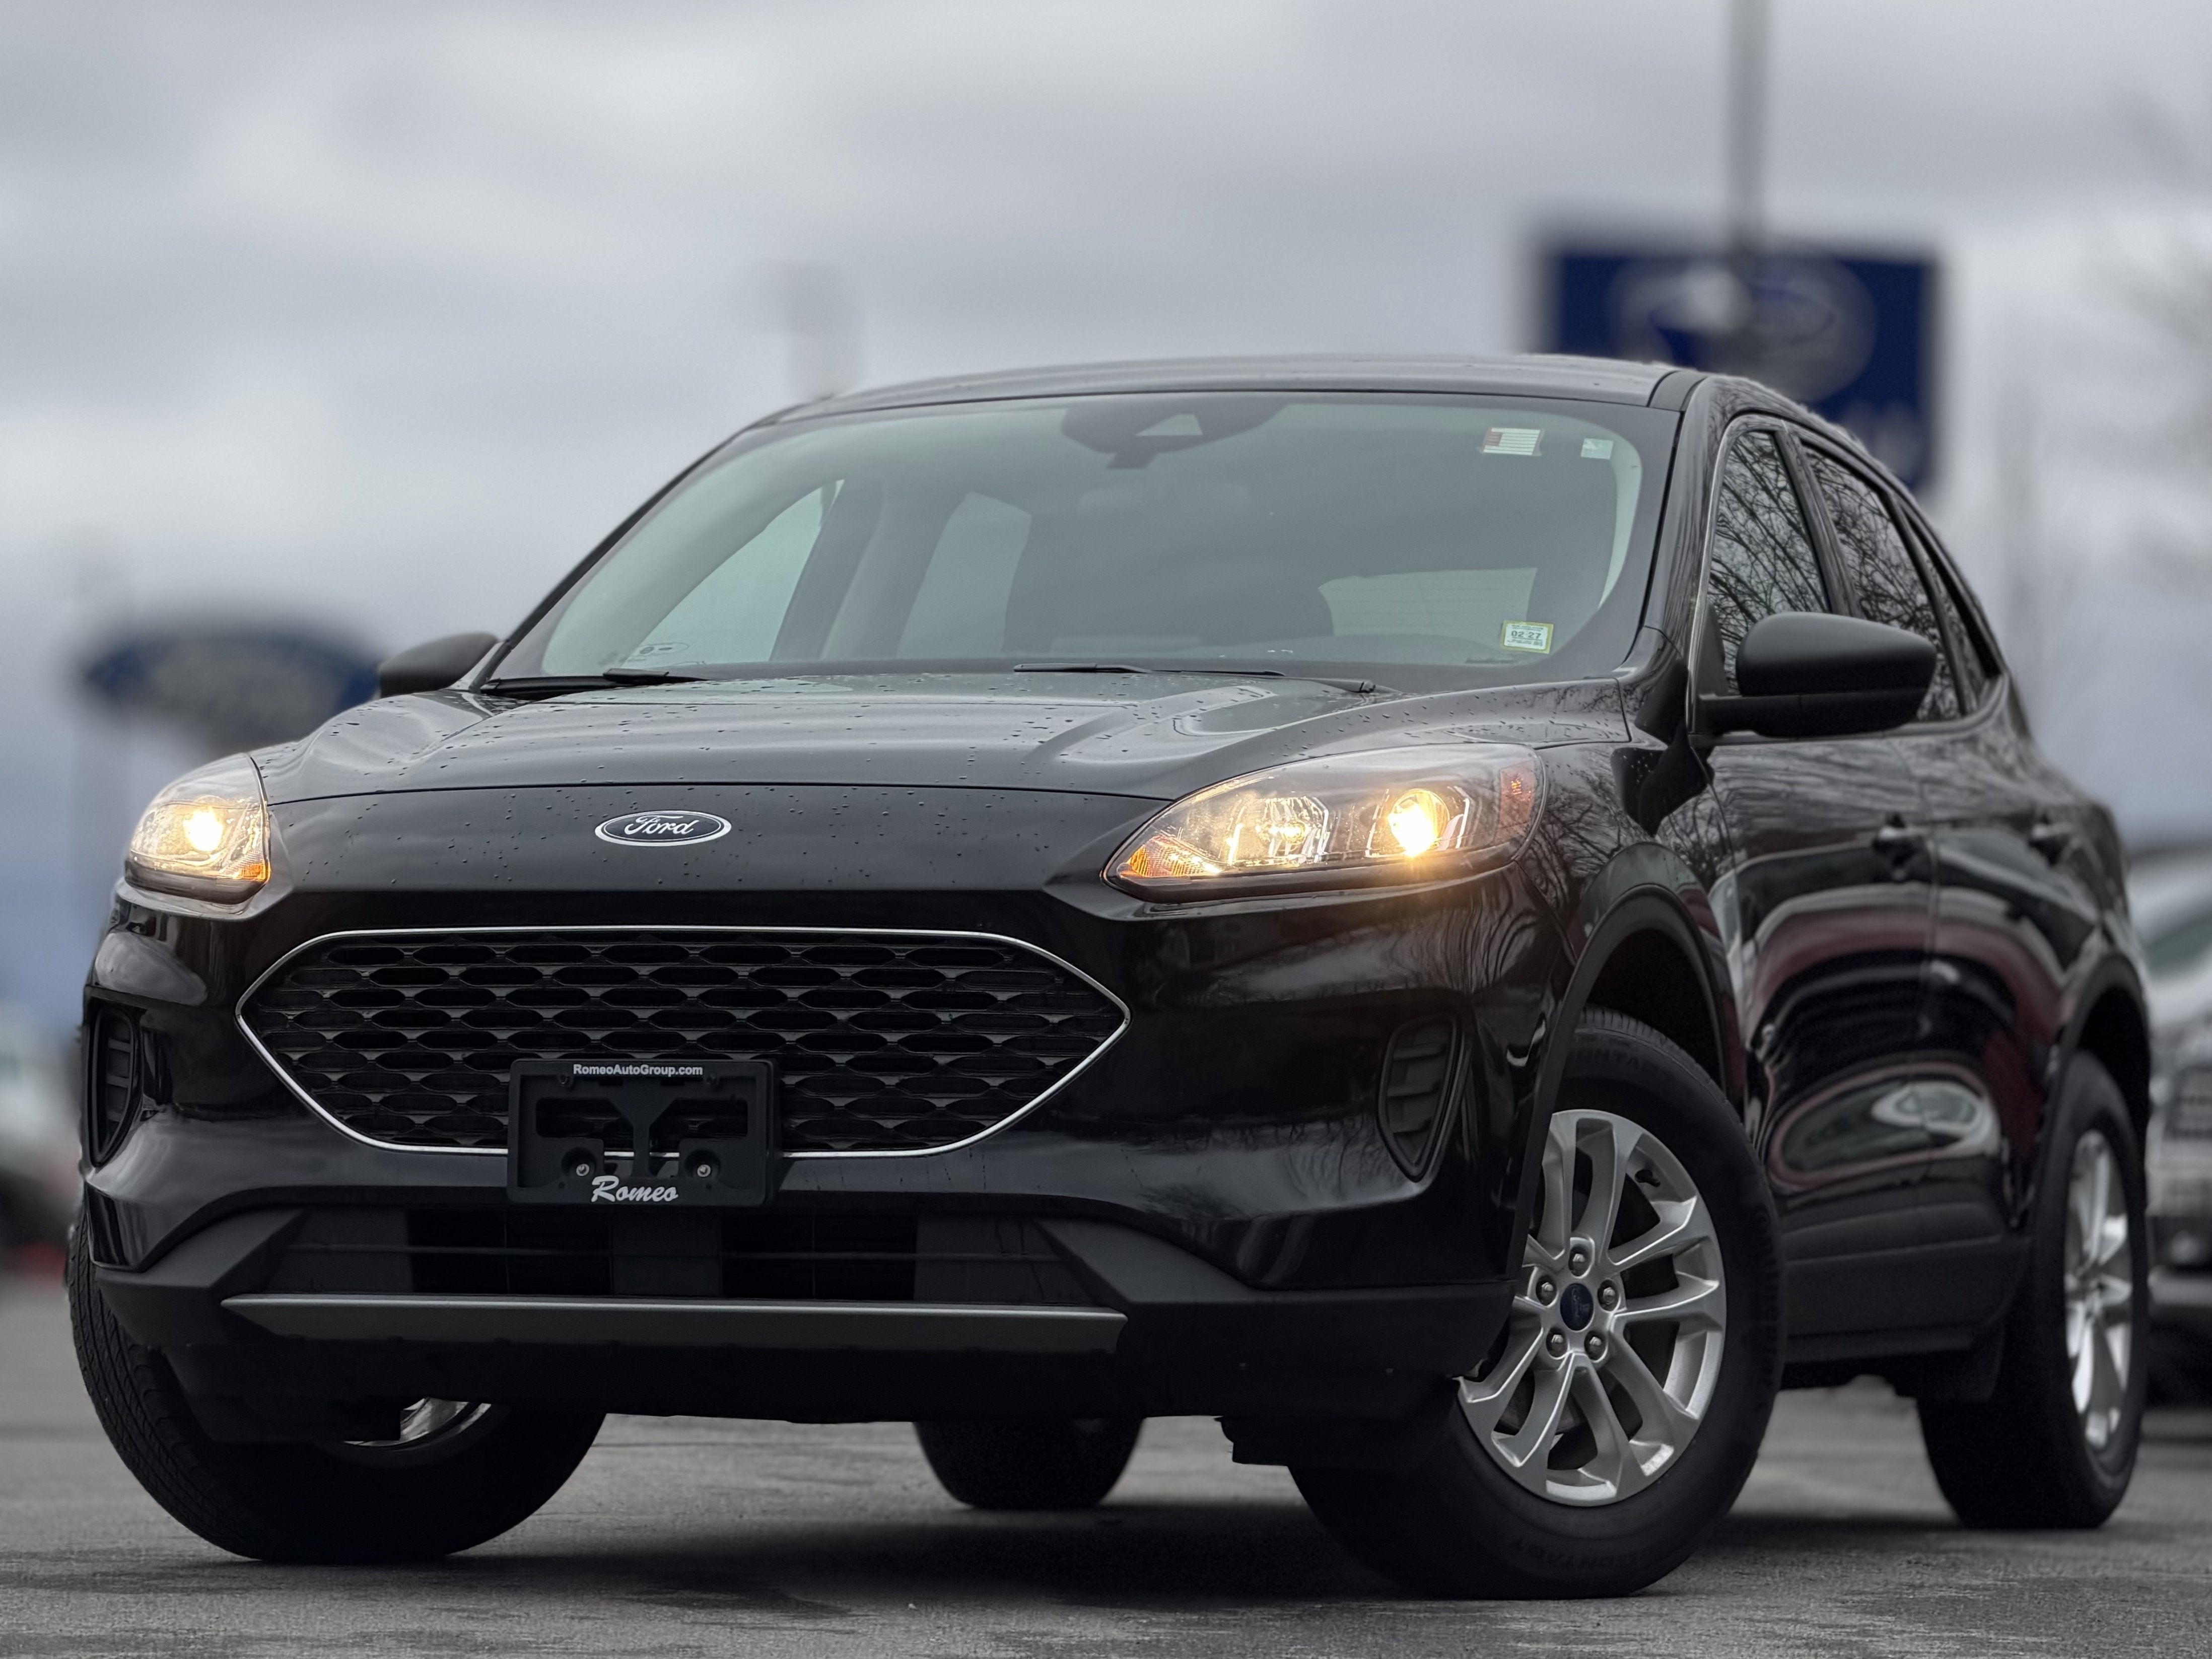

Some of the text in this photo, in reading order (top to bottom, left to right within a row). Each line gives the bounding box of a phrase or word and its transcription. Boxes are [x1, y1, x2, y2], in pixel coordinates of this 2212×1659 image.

[625, 815, 699, 835] Ford
[573, 1064, 703, 1077] RomeoAutoGroup.com
[591, 1176, 679, 1202] Romeo
